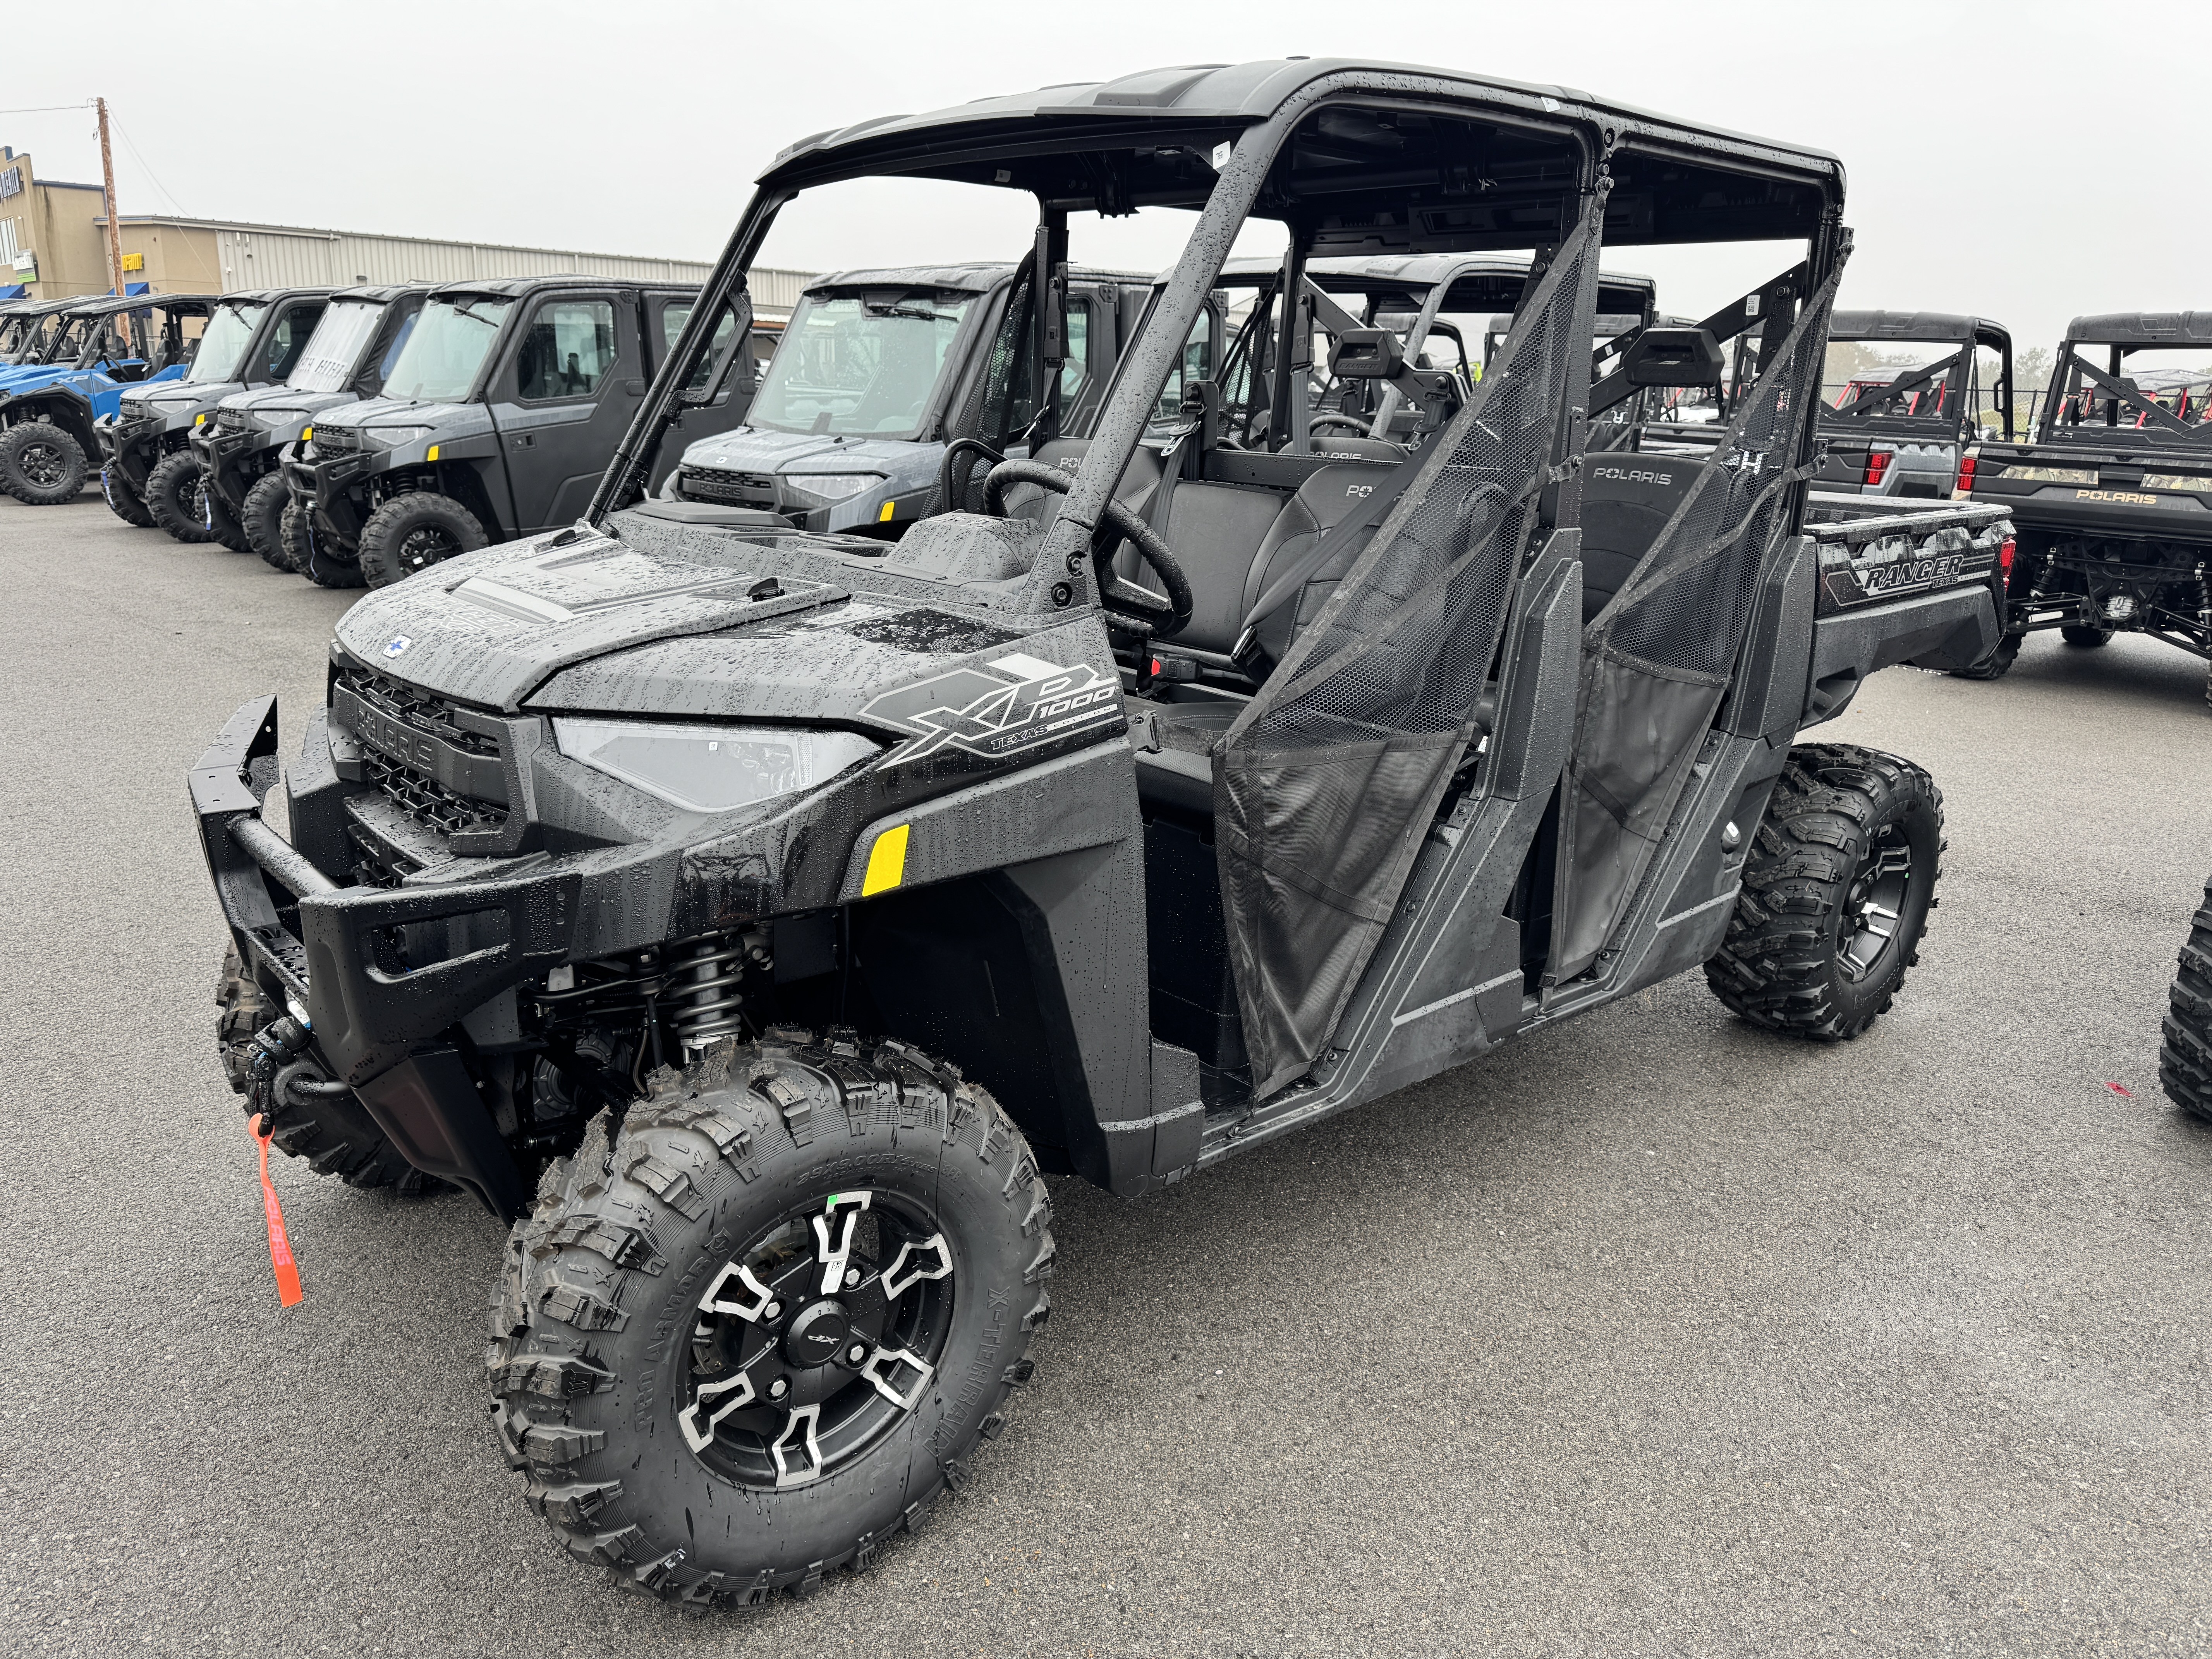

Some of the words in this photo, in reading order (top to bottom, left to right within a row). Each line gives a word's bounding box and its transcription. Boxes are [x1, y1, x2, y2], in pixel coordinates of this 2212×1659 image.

[57, 374, 89, 384] XP
[699, 483, 741, 498] POLARIS
[1593, 468, 1672, 485] POLARIS
[2076, 489, 2157, 505] POLARIS
[1862, 555, 1964, 591] RANGER
[1931, 576, 1959, 588] TEXAS
[407, 594, 520, 633] RANGER
[424, 615, 482, 633] XP
[875, 663, 1117, 772] XP
[1039, 685, 1117, 720] 1000
[991, 724, 1049, 750] TEXAS
[1053, 707, 1112, 728] EDITION
[264, 1186, 292, 1266] POLARIS
[644, 1256, 711, 1362] ARMOR
[923, 1286, 1010, 1458] X-TERRAIN
[634, 1370, 656, 1432] PRO
